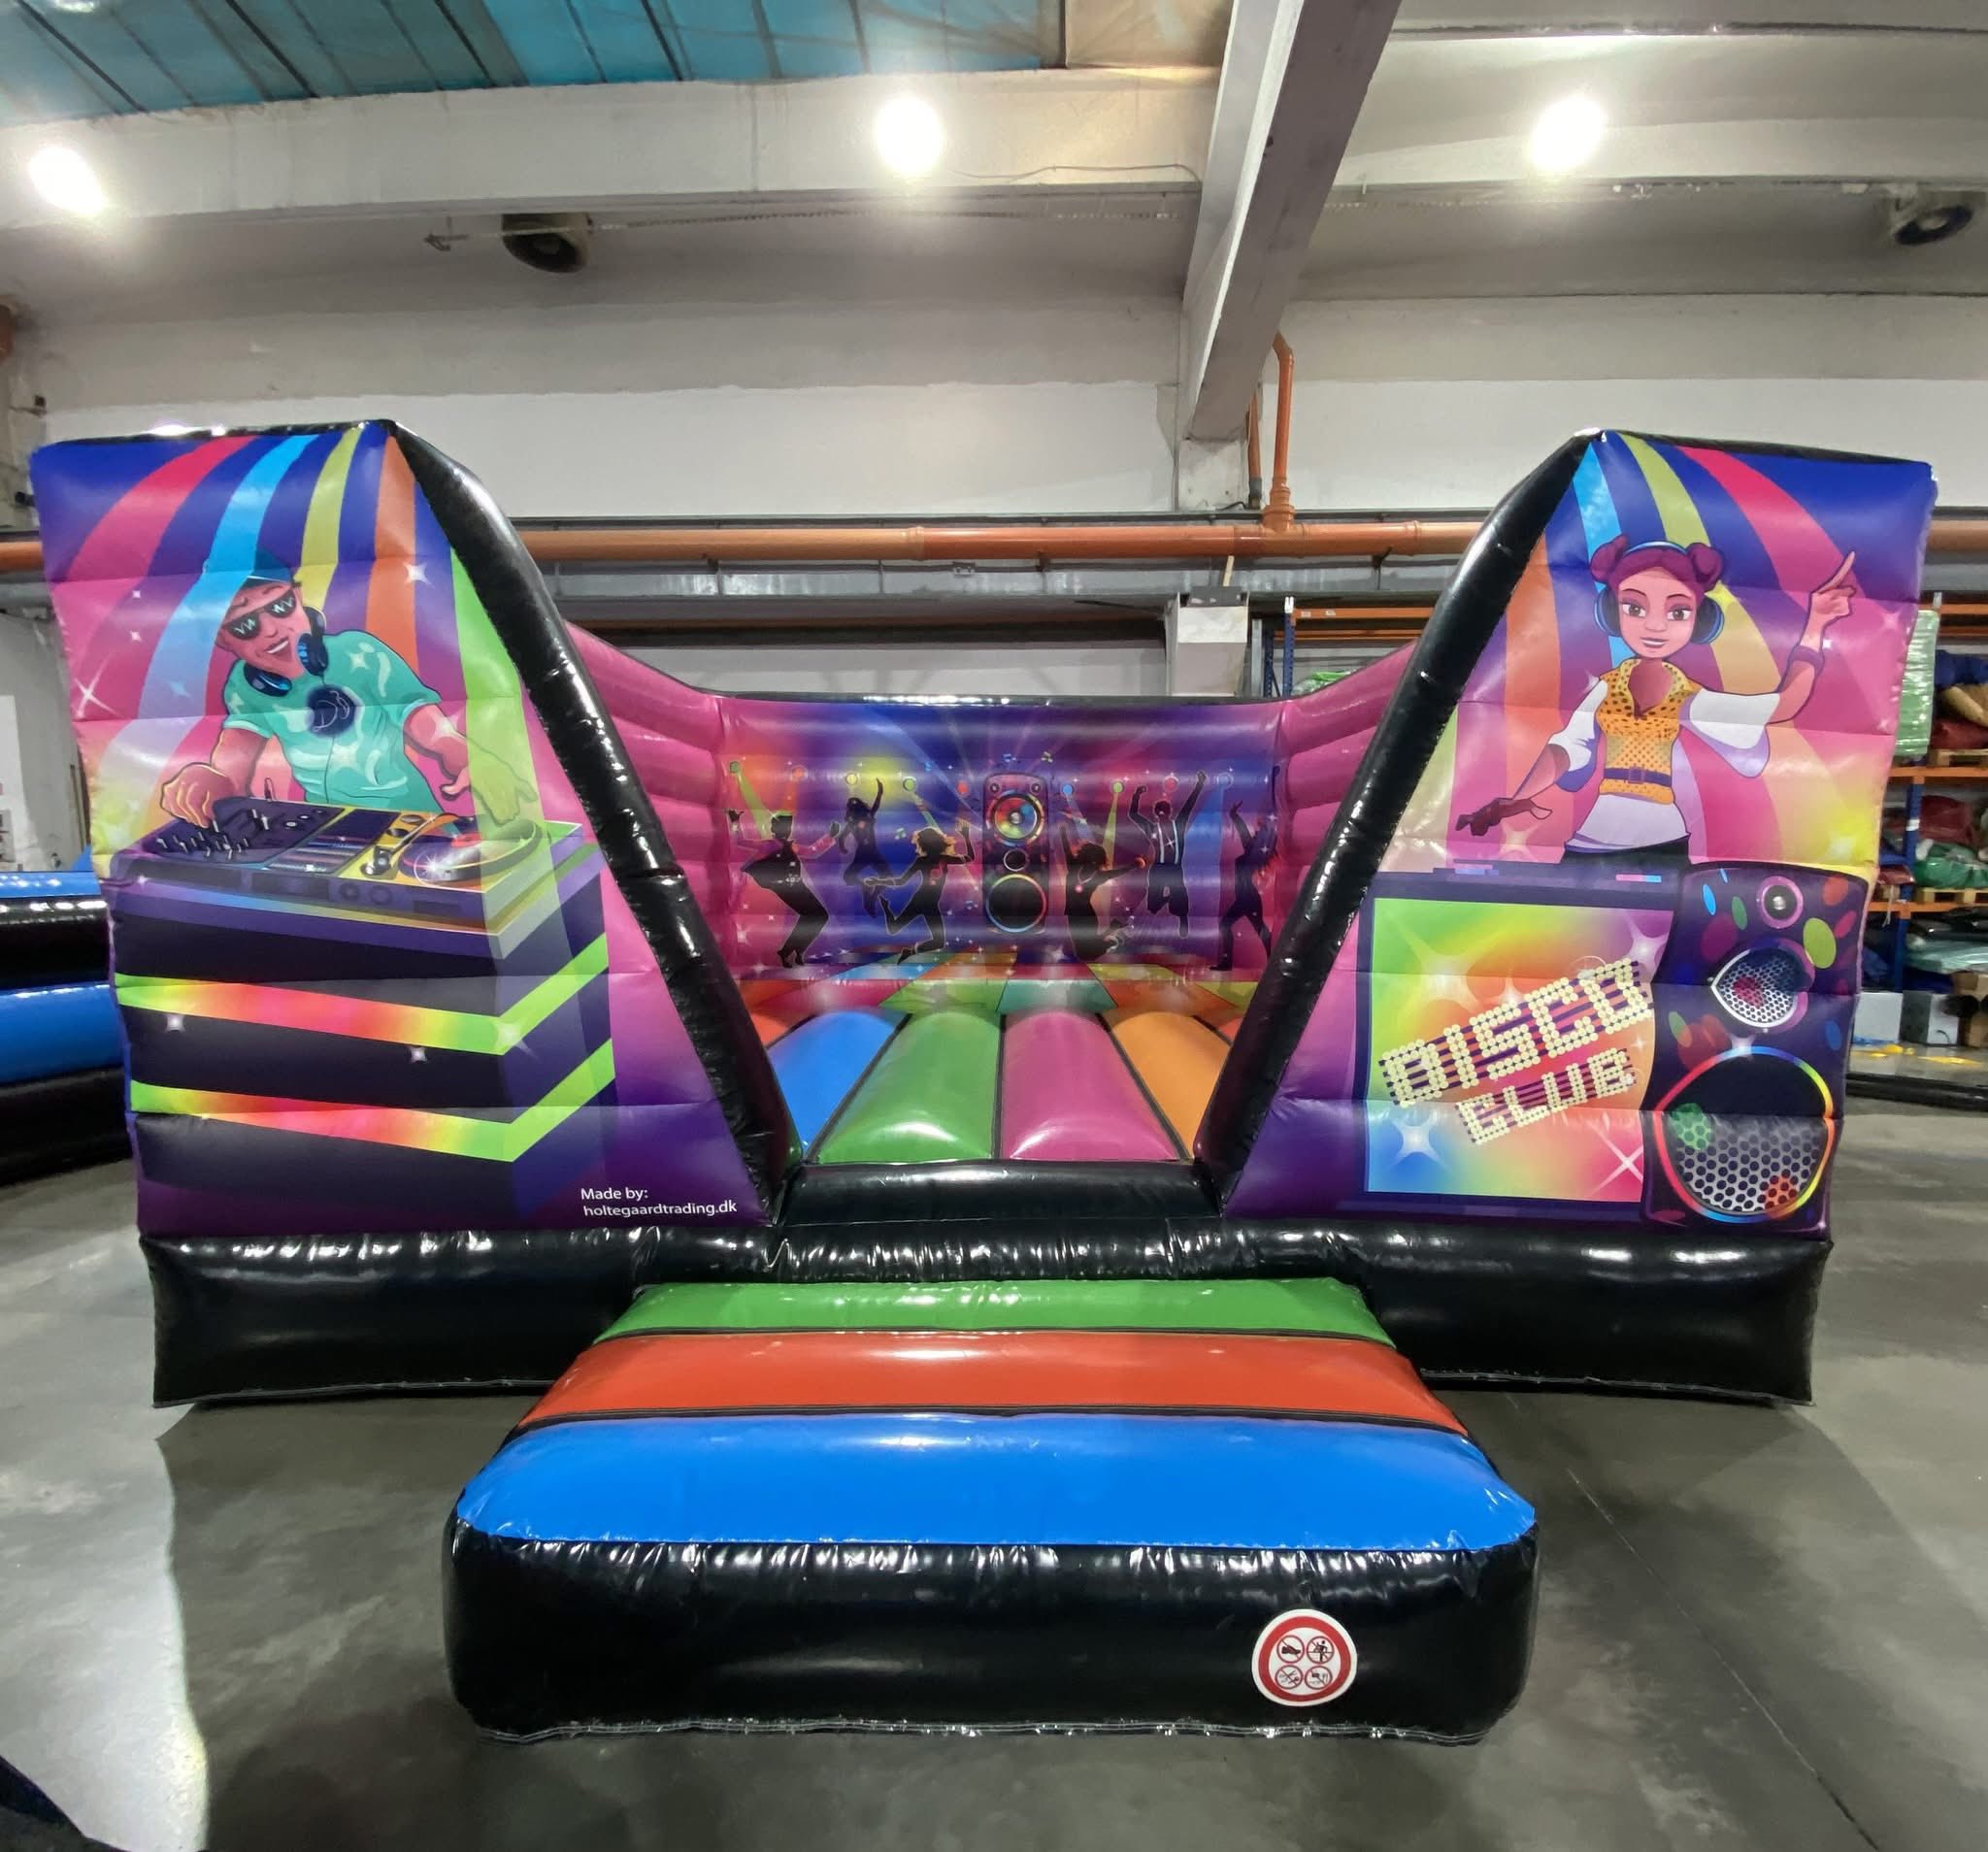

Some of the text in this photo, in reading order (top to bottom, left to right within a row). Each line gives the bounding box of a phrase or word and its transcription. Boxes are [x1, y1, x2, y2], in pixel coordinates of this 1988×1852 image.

[1381, 957, 1653, 1108] DISCO
[1457, 1047, 1637, 1145] CLUB
[580, 1187, 648, 1202] Made by:
[583, 1200, 738, 1218] holtegaardtrading.dk
